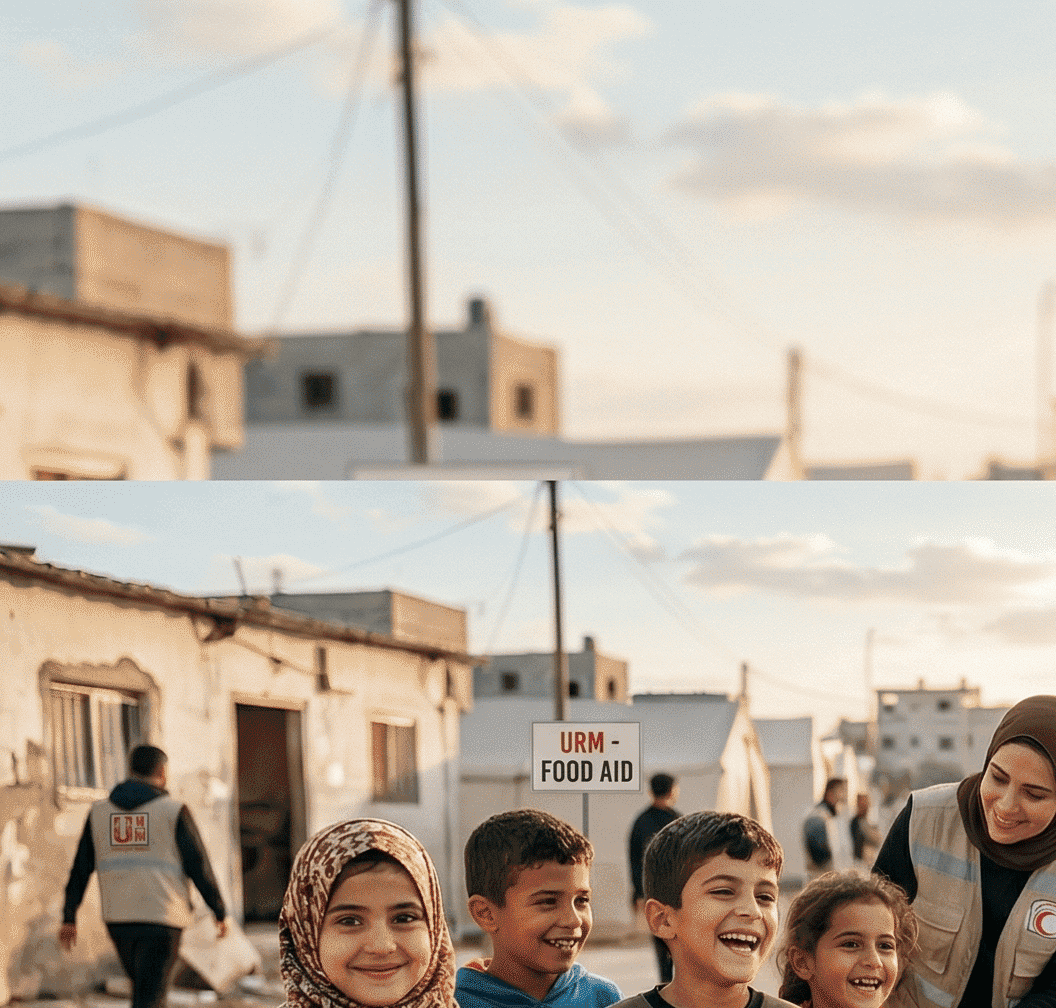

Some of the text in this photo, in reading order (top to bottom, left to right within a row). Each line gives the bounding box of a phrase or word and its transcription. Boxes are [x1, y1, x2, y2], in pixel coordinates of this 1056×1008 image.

[560, 731, 604, 754] URM
[541, 760, 633, 783] FOOD AID
